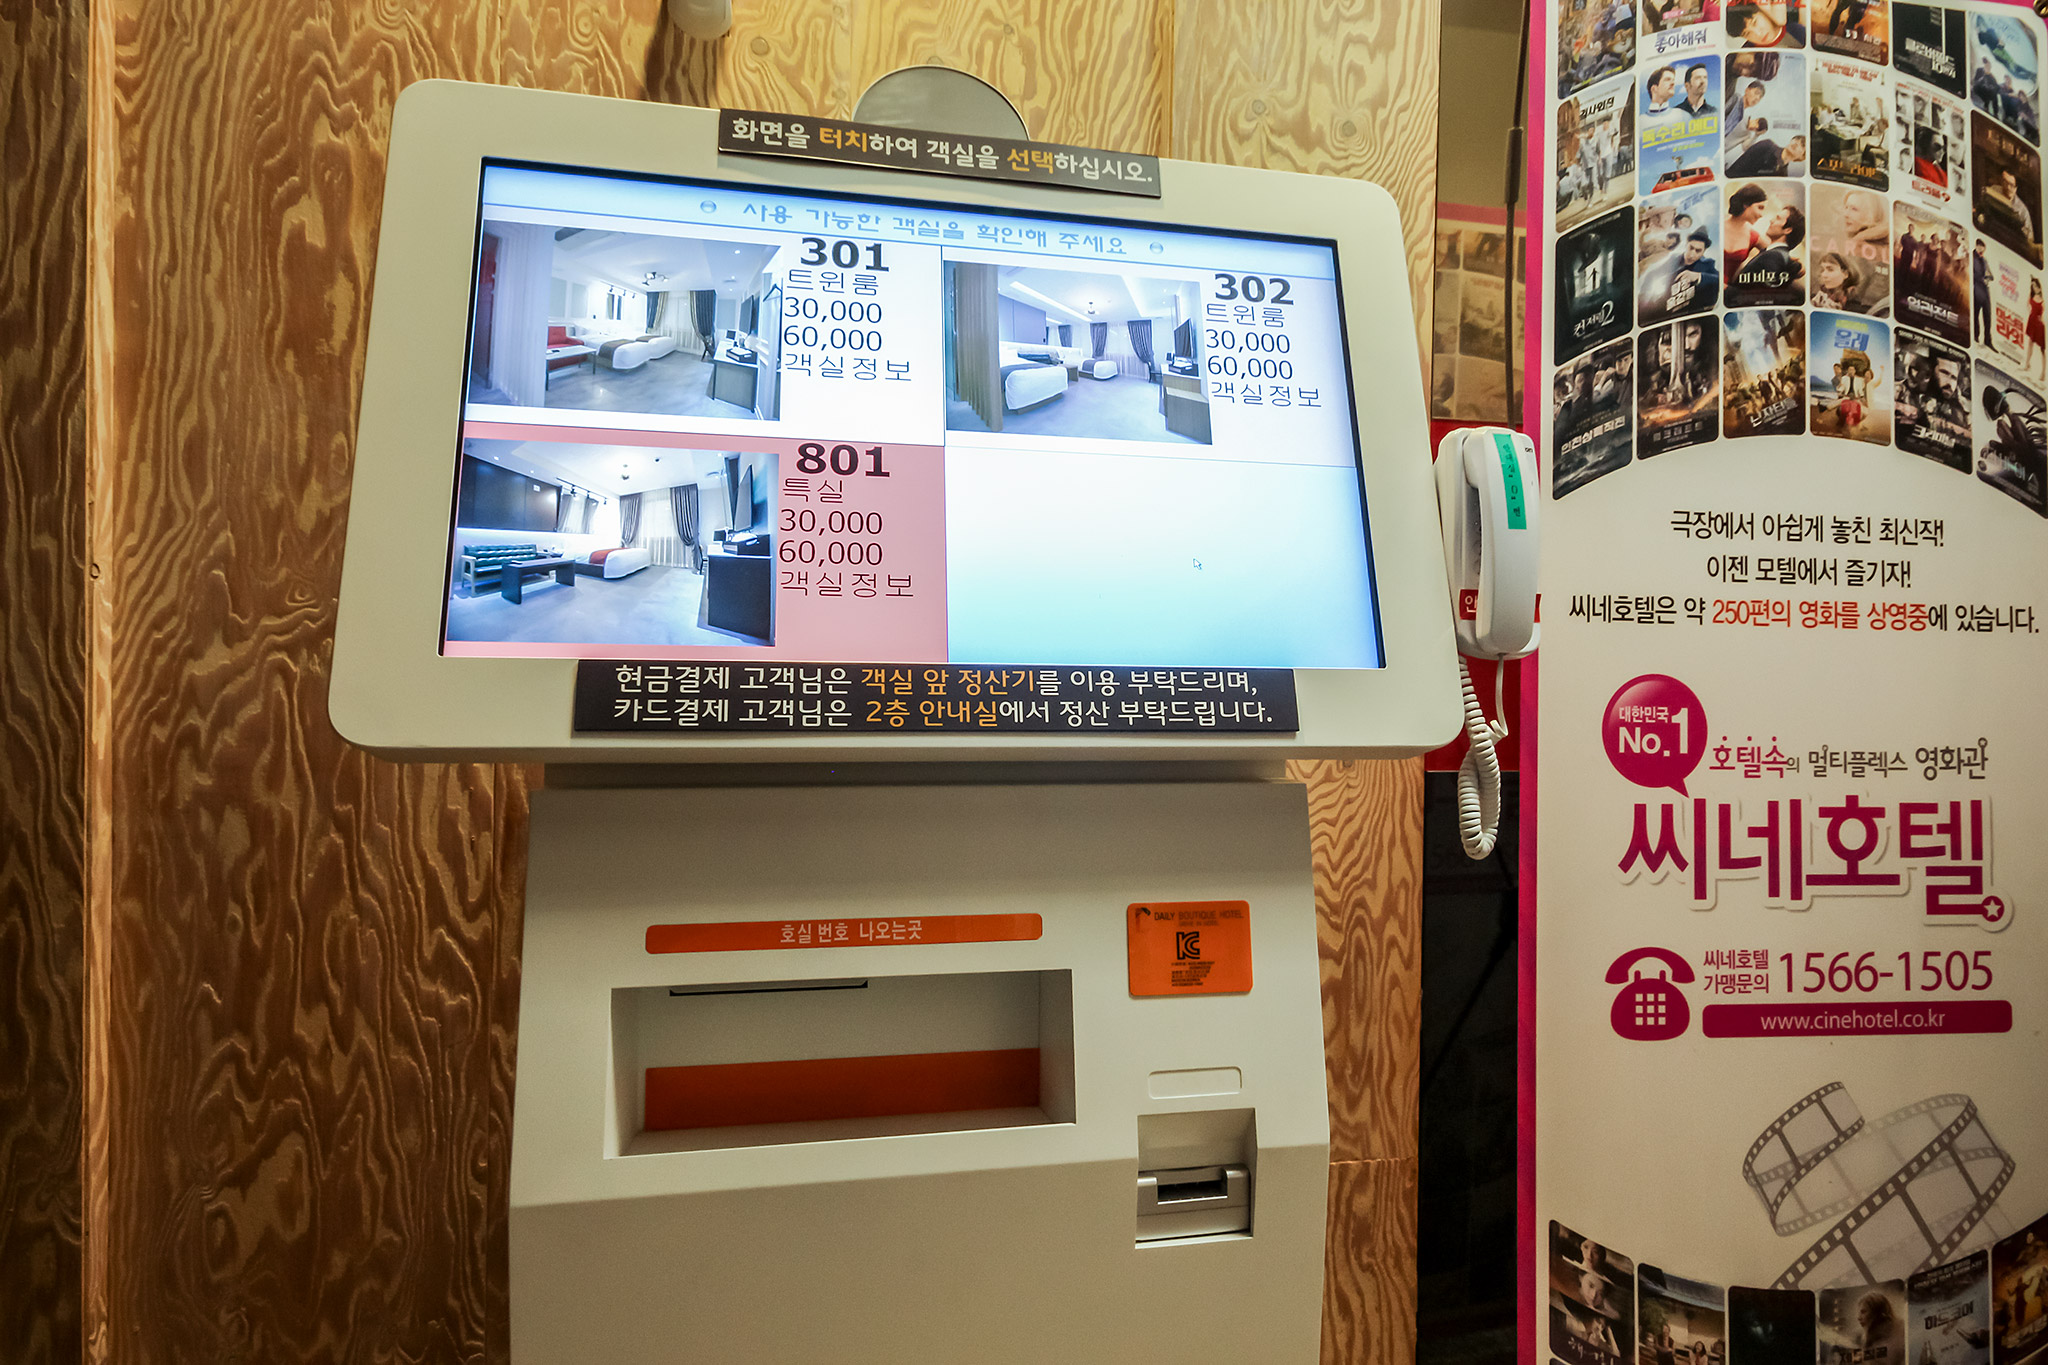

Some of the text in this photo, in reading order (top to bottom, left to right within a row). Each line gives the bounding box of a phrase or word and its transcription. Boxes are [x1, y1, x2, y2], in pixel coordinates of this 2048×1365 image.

[732, 117, 1153, 183] 화면을 터치하여 객실을 선택하십시오.
[743, 202, 1127, 255] 사용 가능한 객실을 확인해 주세요
[800, 237, 890, 272] 301
[786, 269, 879, 296] 트윈룸
[1214, 273, 1294, 306] 302
[784, 297, 882, 323] 30,000
[1206, 303, 1285, 328] 트윈룸
[783, 325, 882, 351] 60,000
[1205, 329, 1290, 354] 30,000
[785, 353, 912, 382] 객실정보
[1207, 355, 1293, 380] 60,000
[1211, 381, 1322, 408] 객실정보
[796, 442, 890, 478] 801
[782, 478, 844, 504] 특실
[780, 509, 883, 536] 30,000
[1670, 510, 1945, 547] 극장에서 아쉽게 놓친 최신작!
[779, 540, 883, 567] 60,000
[781, 571, 914, 598] 객실정보
[1707, 555, 1912, 589] 이젠 모텔에서 즐기자!
[1569, 594, 2039, 634] 씨네호텔은 약 250편의 영화를 상영중에 있습니다.
[615, 664, 1257, 697] 현금결제 고객님은 객실 앞 정산기를 이용 부탁드리며,
[613, 698, 1273, 728] 카드결제 고객님은 2층 안내실에서 정산 부탁드립니다.
[1618, 705, 1669, 724] 대한민국
[1618, 707, 1689, 758] No.1
[1709, 736, 1988, 781] 호텔속의 멀티플렉스 영화관
[1618, 795, 2004, 923] 씨네호텔
[780, 919, 922, 944] 호실 번호 나오는곳
[1703, 949, 1993, 993] 씨네호텔 1566-1505
[1703, 973, 1769, 995] 가맹문의
[1760, 1010, 1946, 1031] www.cinehotel.co.kr
